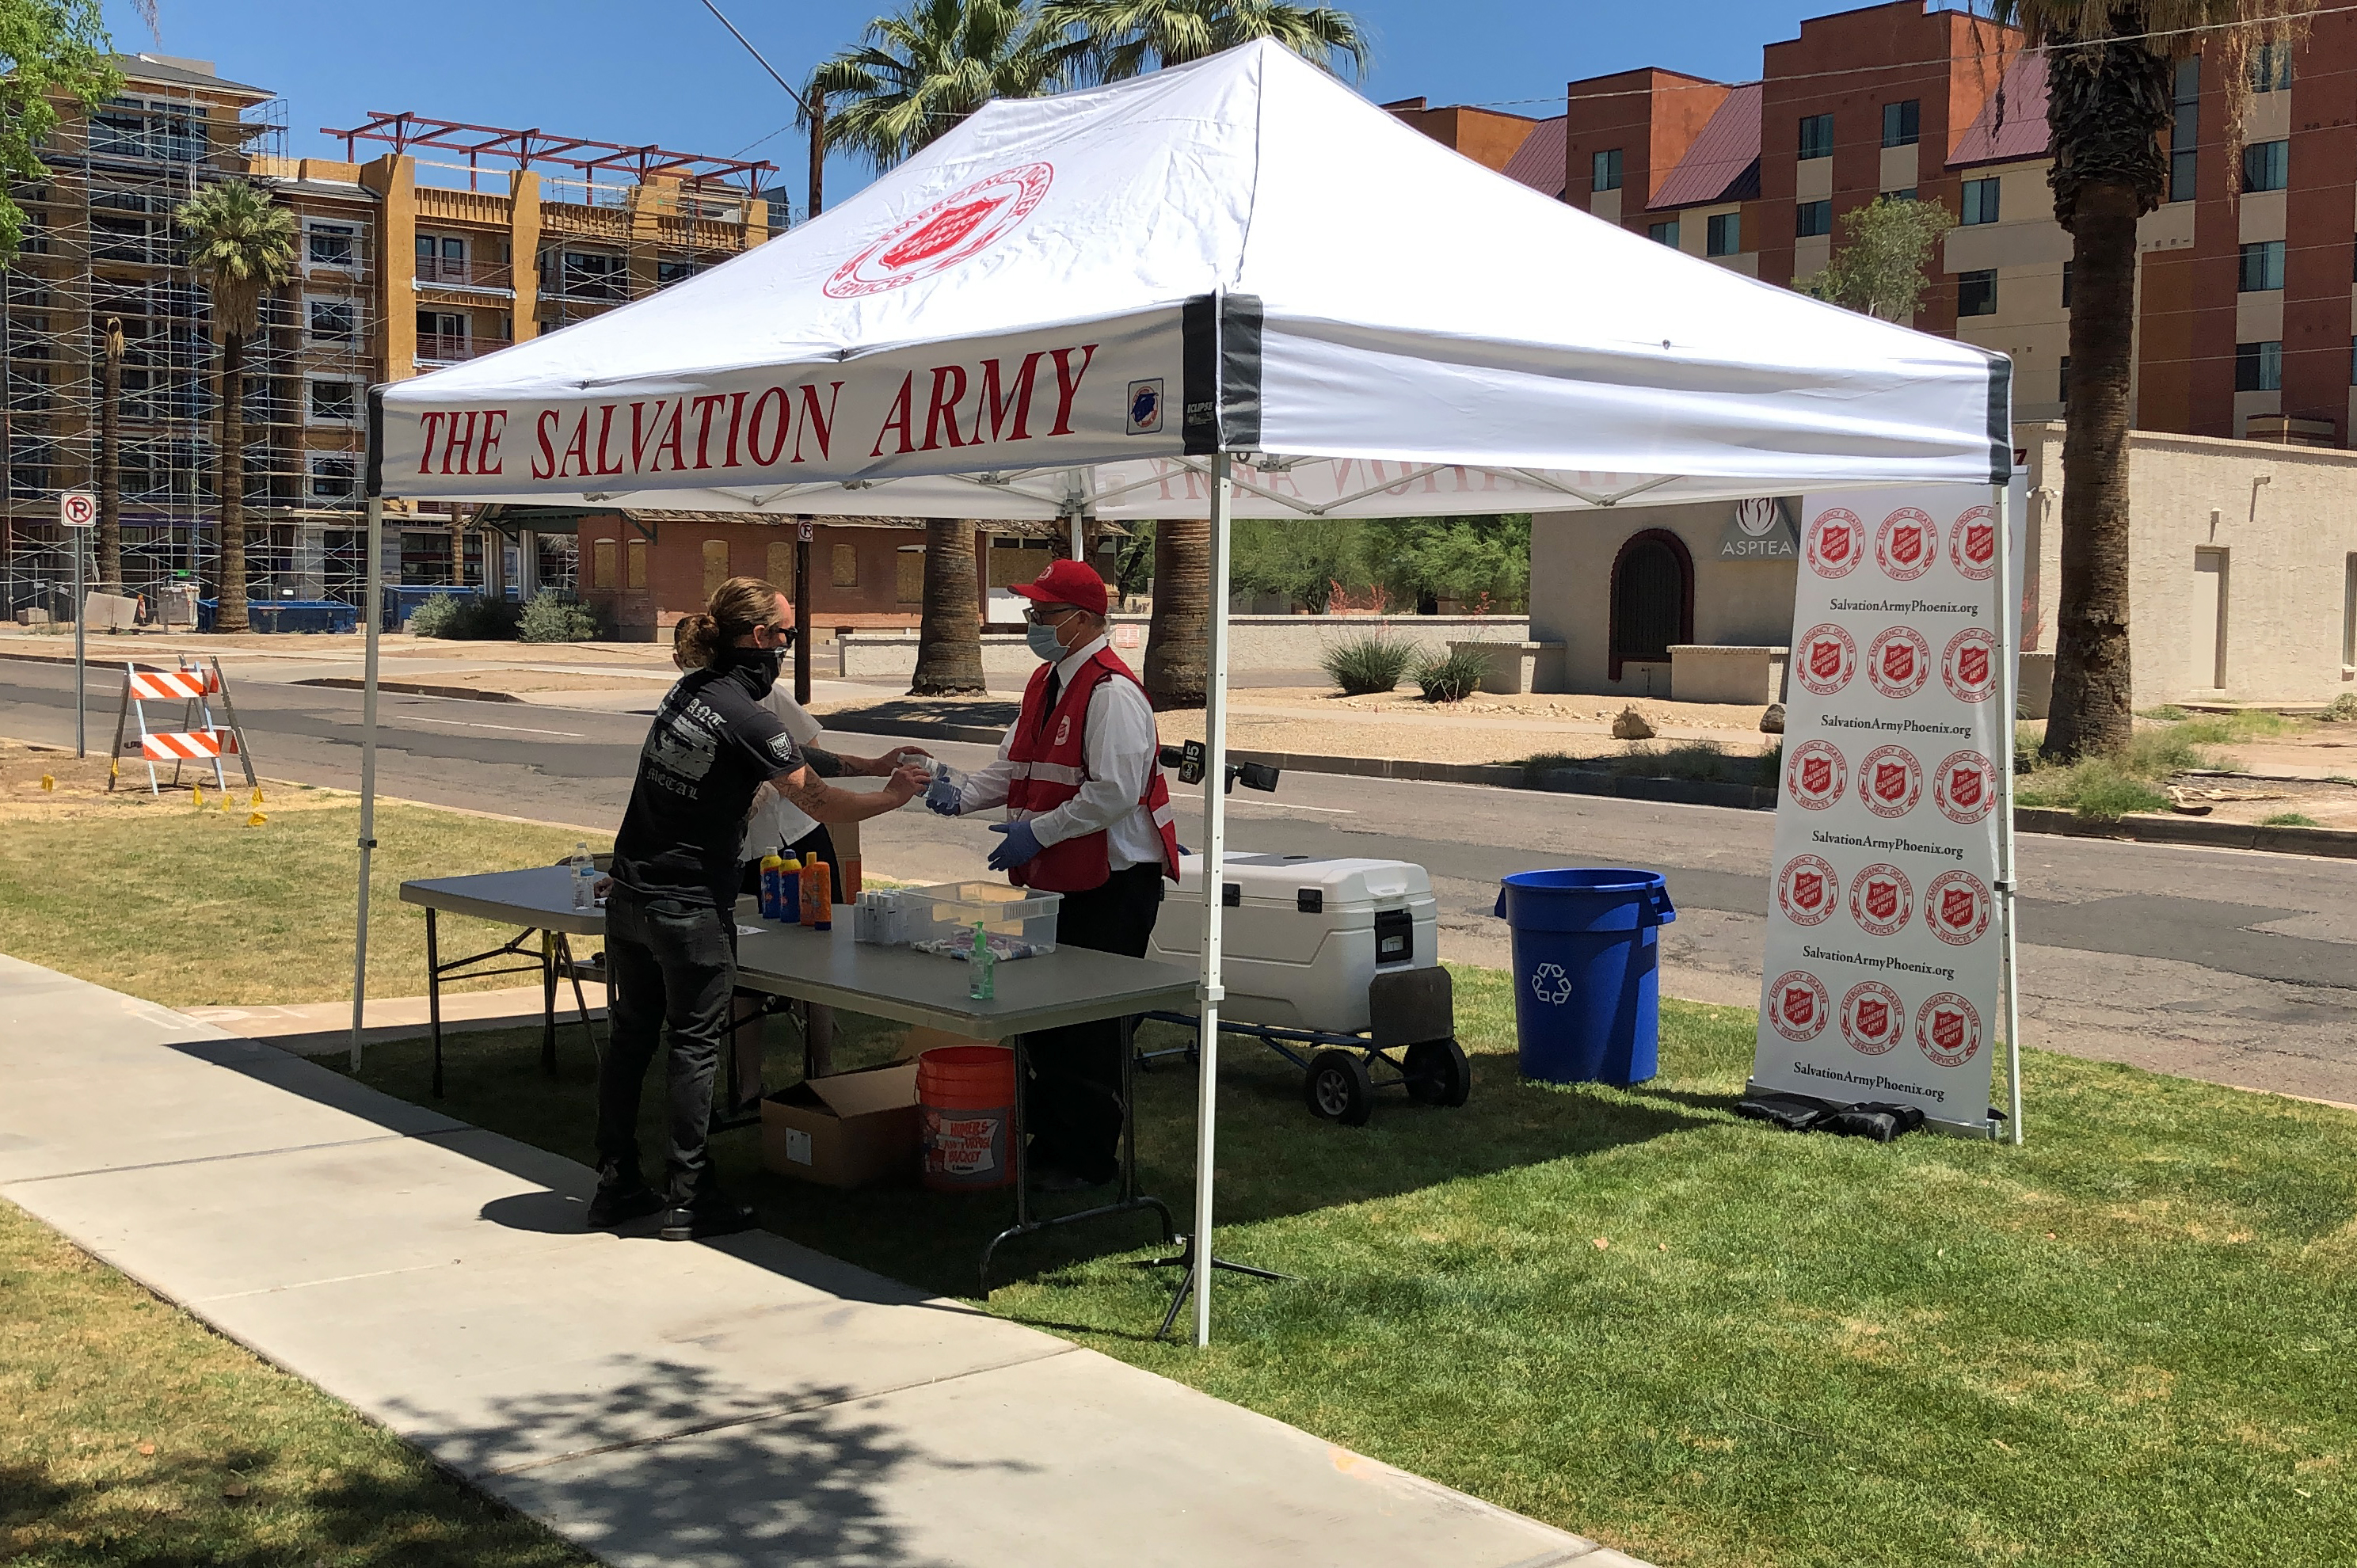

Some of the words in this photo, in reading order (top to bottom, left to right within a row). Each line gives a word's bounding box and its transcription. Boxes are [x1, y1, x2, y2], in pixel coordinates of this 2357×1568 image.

[417, 409, 508, 475] THE
[531, 380, 845, 481] SALVATION
[869, 344, 1100, 457] ARMY
[1721, 540, 1792, 556] ASPTEA
[1830, 598, 1978, 617] SalvationArmyPhoenix.org
[1821, 714, 1971, 739] SalvationArmyPhoenix.org
[1186, 744, 1200, 762] 15
[1790, 743, 1821, 769] EMERGENCY
[1861, 748, 1894, 775] EMERGENCY
[1936, 753, 1971, 780] EMERGENCY
[1799, 797, 1830, 808] SERVICES
[1872, 805, 1904, 816] SERVICES
[1948, 810, 1980, 821] SERVICES
[1811, 829, 1964, 861] SalvationArmyPhoenix.org
[1780, 857, 1812, 883] EMERGENCY
[1815, 859, 1836, 887] DISASTER
[1799, 876, 1811, 886] THE
[1852, 866, 1887, 892] EMERGENCY
[1890, 869, 1910, 896] DISASTER
[1928, 873, 1963, 900] EMERGENCY
[1967, 876, 1989, 905] DISASTER
[1795, 879, 1820, 900] SALVATION
[1803, 889, 1819, 904] ARMY
[1873, 885, 1884, 896] THE
[1868, 888, 1894, 909] SALVATION
[1876, 899, 1893, 914] ARMY
[1948, 893, 1961, 904] THE
[1943, 896, 1971, 918] SALVATION
[1951, 907, 1970, 923] ARMY
[1789, 911, 1820, 924] SERVICES
[1863, 922, 1895, 934] SERVICES
[1939, 931, 1971, 943] SERVICES
[1802, 945, 1955, 981] SalvationArmyPhoenix.org
[1771, 973, 1803, 998] EMERGENCY
[1807, 976, 1826, 1004] DISASTER
[1785, 995, 1811, 1014] SALVATION
[1790, 992, 1801, 1003] THE
[1843, 984, 1877, 1010] EMERGENCY
[1881, 987, 1902, 1016] DISASTER
[1793, 1006, 1810, 1020] ARMY
[1864, 1003, 1875, 1014] THE
[1918, 995, 1953, 1022] EMERGENCY
[1957, 998, 1979, 1027] DISASTER
[1858, 1007, 1885, 1027] SALVATION
[1940, 1014, 1951, 1026] THE
[1780, 1026, 1811, 1040] SERVICES
[1867, 1018, 1883, 1033] ARMY
[1934, 1018, 1961, 1038] SALVATION
[1943, 1029, 1960, 1045] ARMY
[1853, 1039, 1886, 1053] SERVICES
[1929, 1052, 1962, 1064] SERVICES
[1792, 1061, 1945, 1103] SalvationArmyPhoenix.org
[948, 1150, 981, 1163] BUCKET
